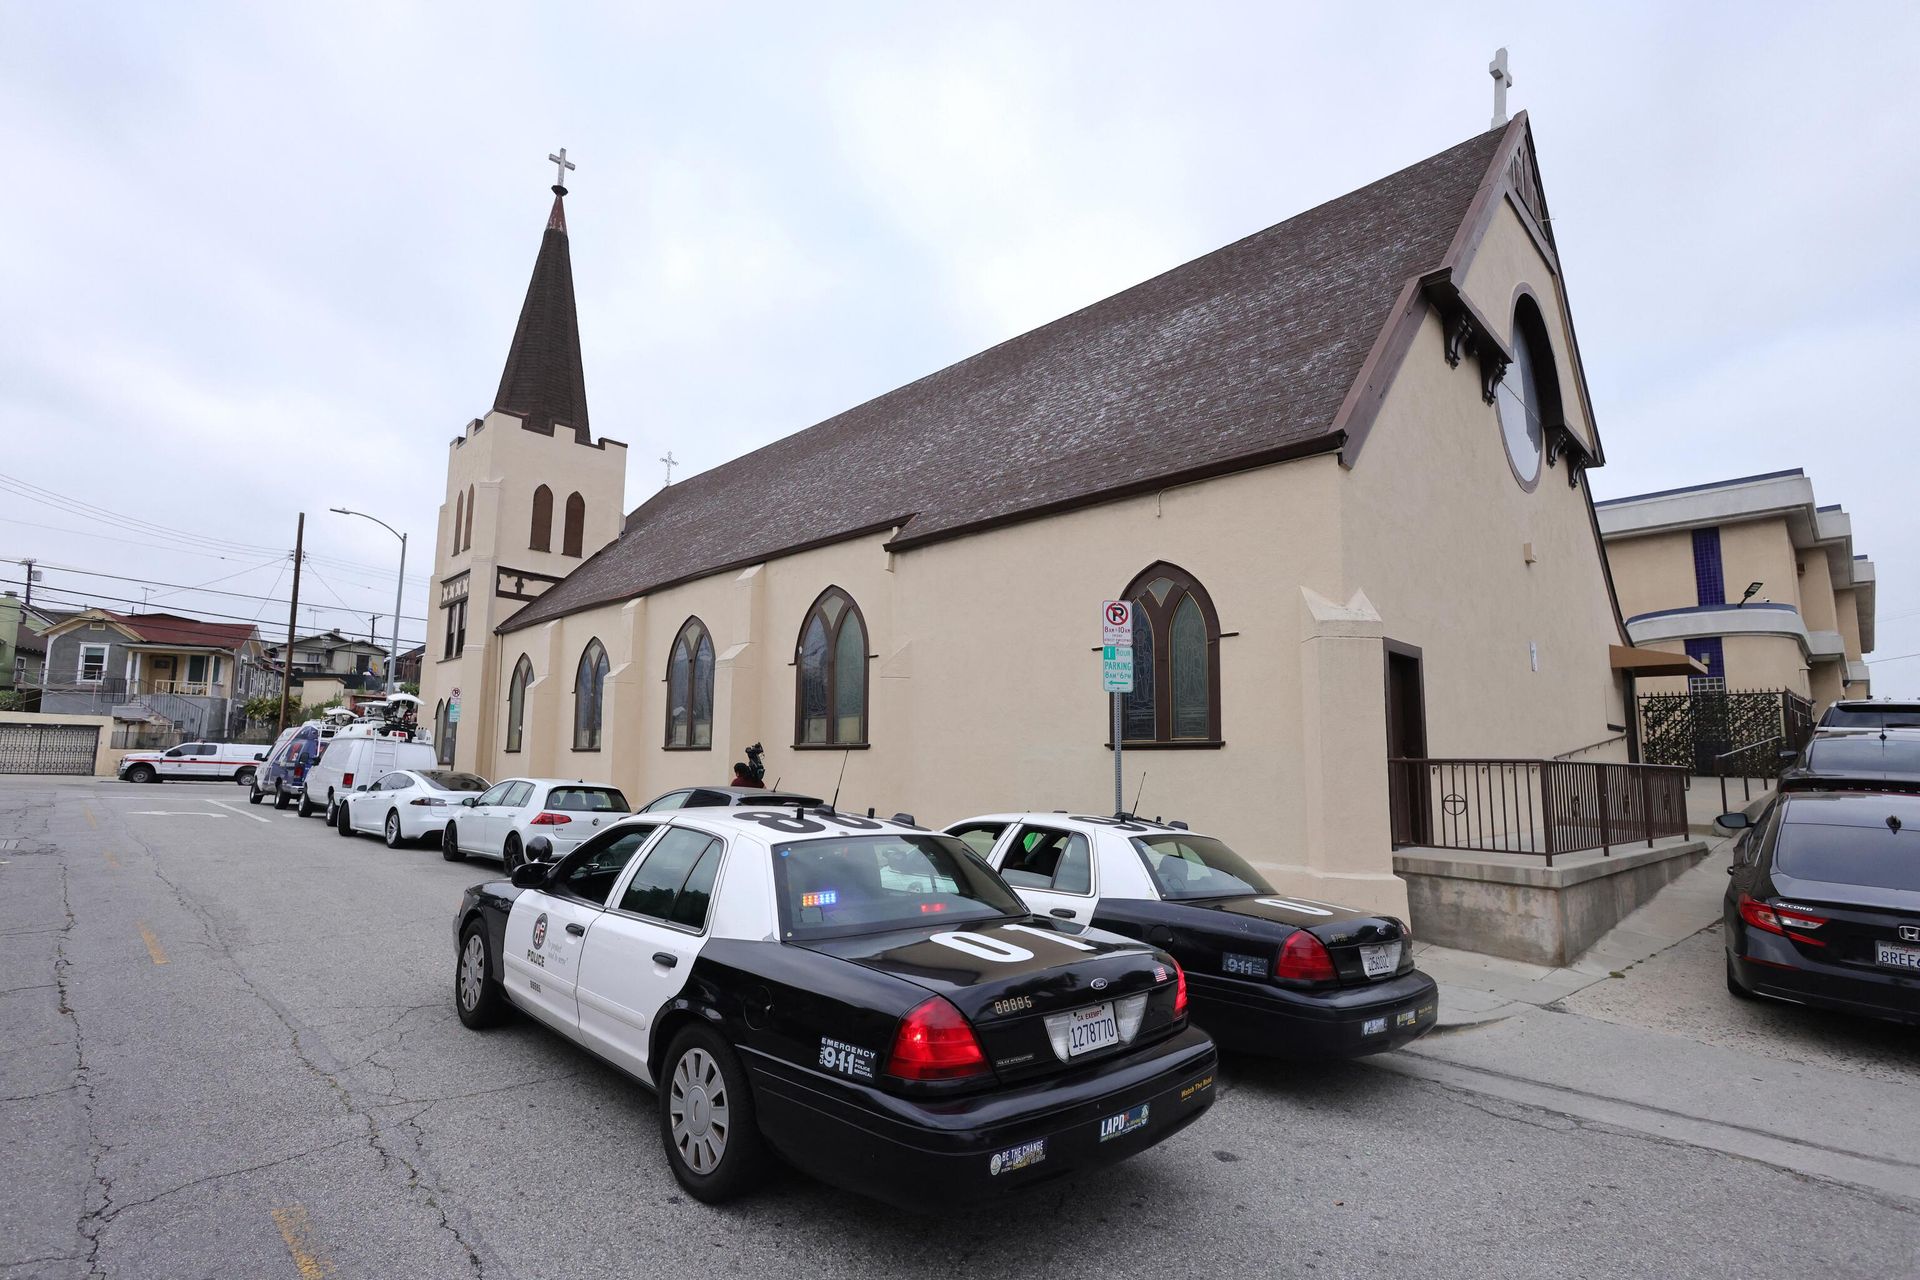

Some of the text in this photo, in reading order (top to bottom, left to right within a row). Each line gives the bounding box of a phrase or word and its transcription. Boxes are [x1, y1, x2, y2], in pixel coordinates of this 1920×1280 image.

[1104, 661, 1132, 670] PARKING
[1776, 902, 1814, 912] ACCORD
[527, 949, 545, 968] POLICE
[1085, 1009, 1103, 1020] EXEMPT
[1071, 1018, 1115, 1049] 1278770
[818, 1045, 826, 1065] CALL
[821, 1037, 876, 1059] EMERGENCY
[854, 1063, 871, 1072] POLICE
[855, 1058, 865, 1066] FIRE
[853, 1068, 873, 1078] MEDICAL
[1101, 1114, 1125, 1137] LAPD
[1002, 1150, 1010, 1162] BE
[1011, 1147, 1022, 1160] THE
[1022, 1140, 1044, 1156] CHANGE
